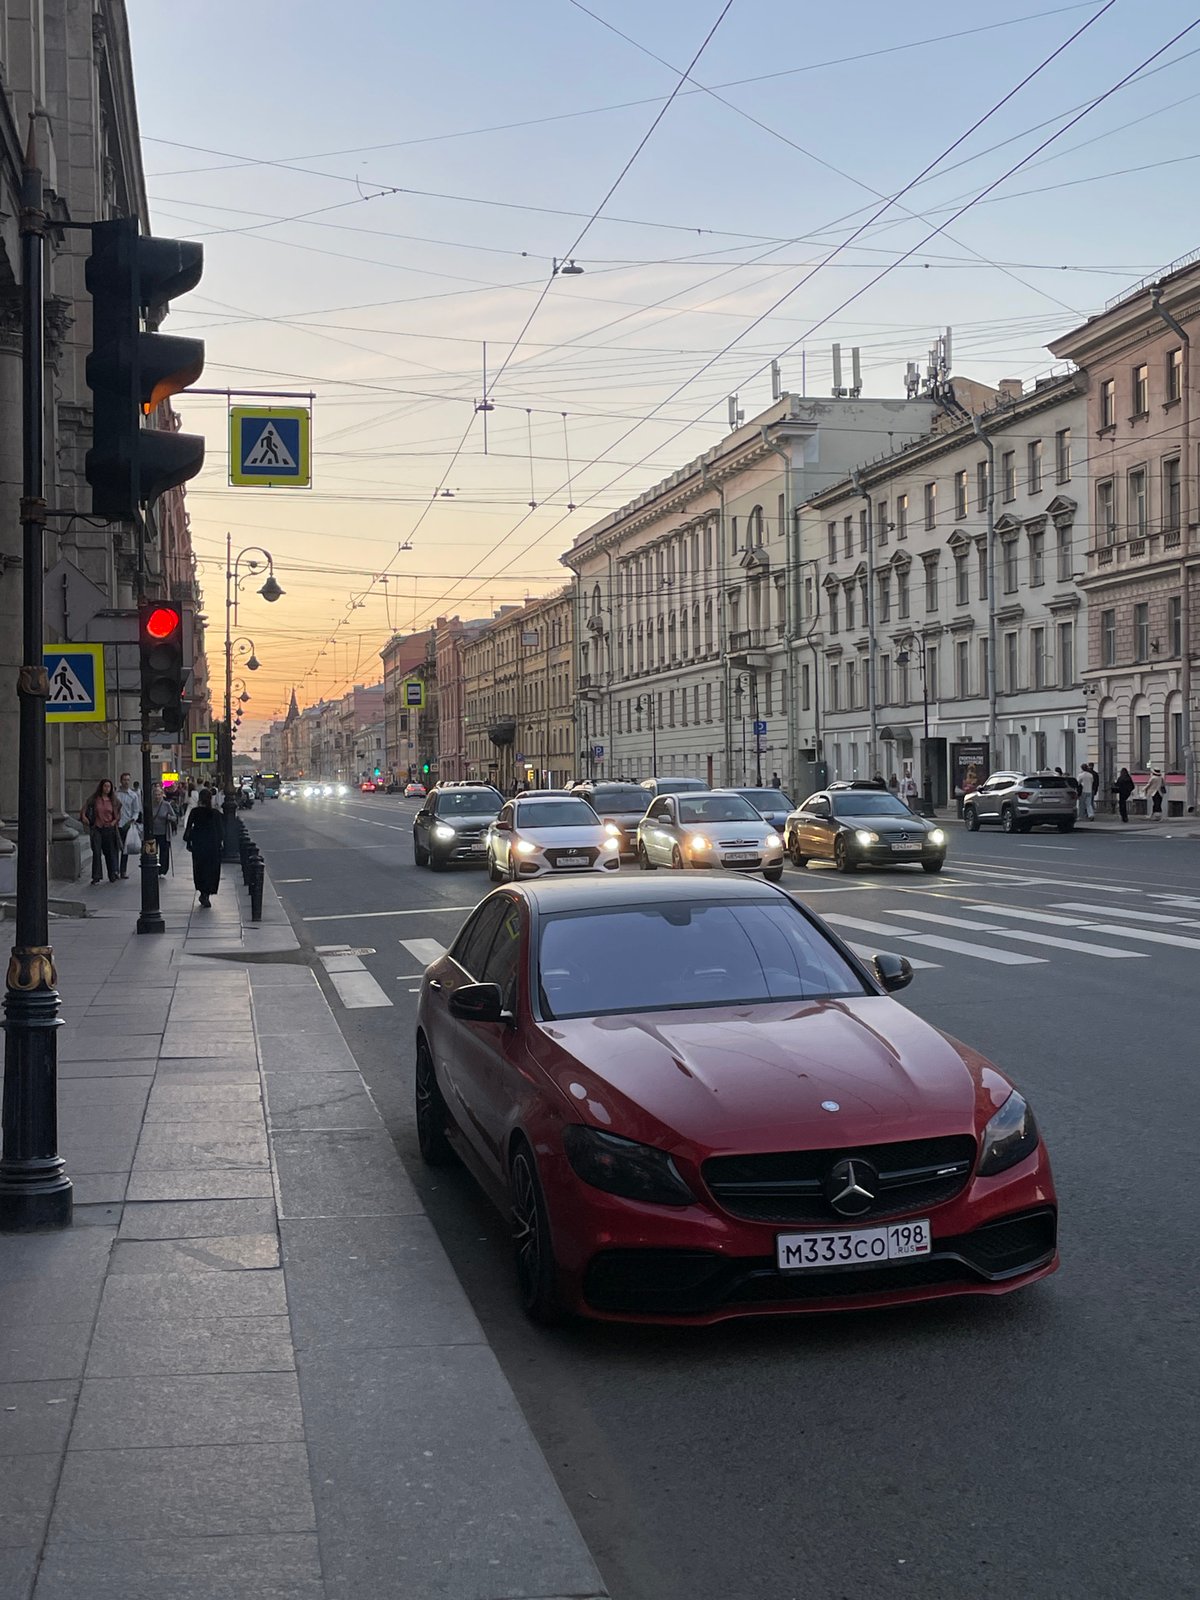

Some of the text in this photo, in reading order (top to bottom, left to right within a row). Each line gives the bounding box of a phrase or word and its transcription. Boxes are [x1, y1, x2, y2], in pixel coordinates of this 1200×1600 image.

[785, 1225, 924, 1265] М333СО 198
[898, 1245, 915, 1254] RUS
